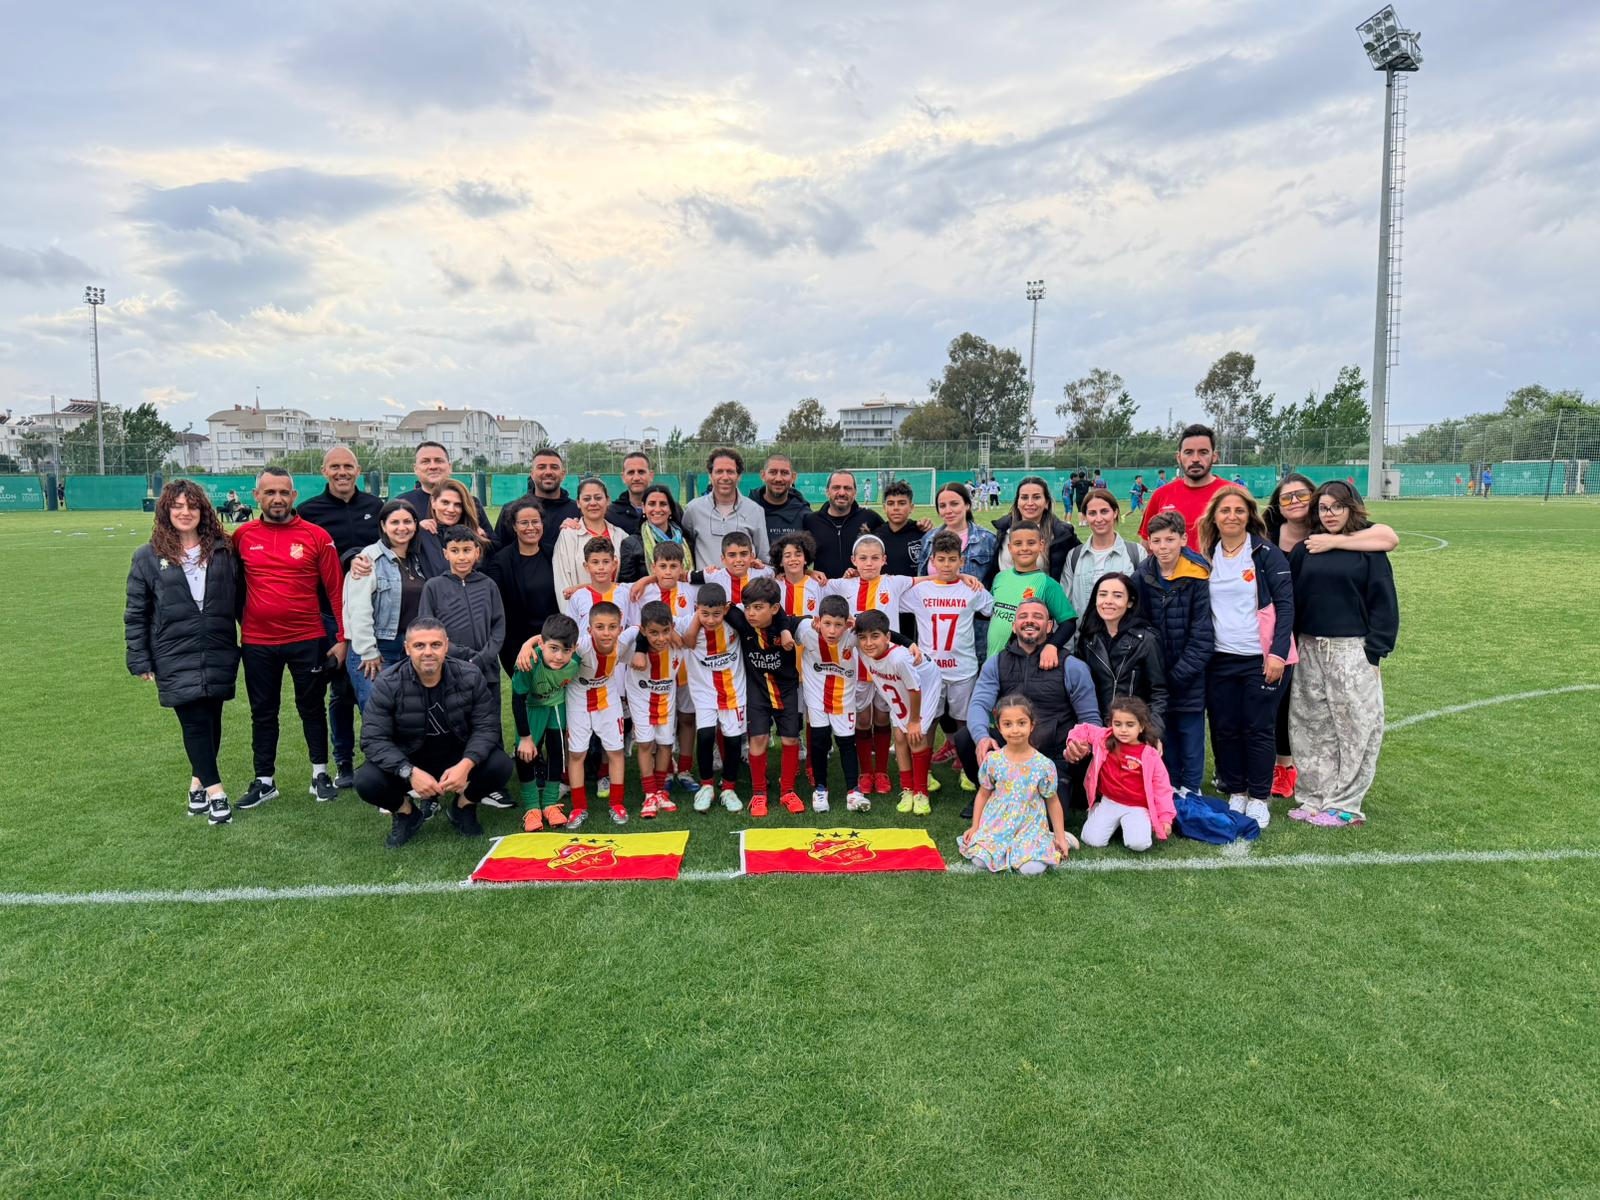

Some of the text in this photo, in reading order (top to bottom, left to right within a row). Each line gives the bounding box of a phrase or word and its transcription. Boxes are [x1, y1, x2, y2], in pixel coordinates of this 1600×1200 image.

[931, 613, 960, 651] 17
[933, 657, 958, 669] AROL
[882, 683, 908, 720] 3
